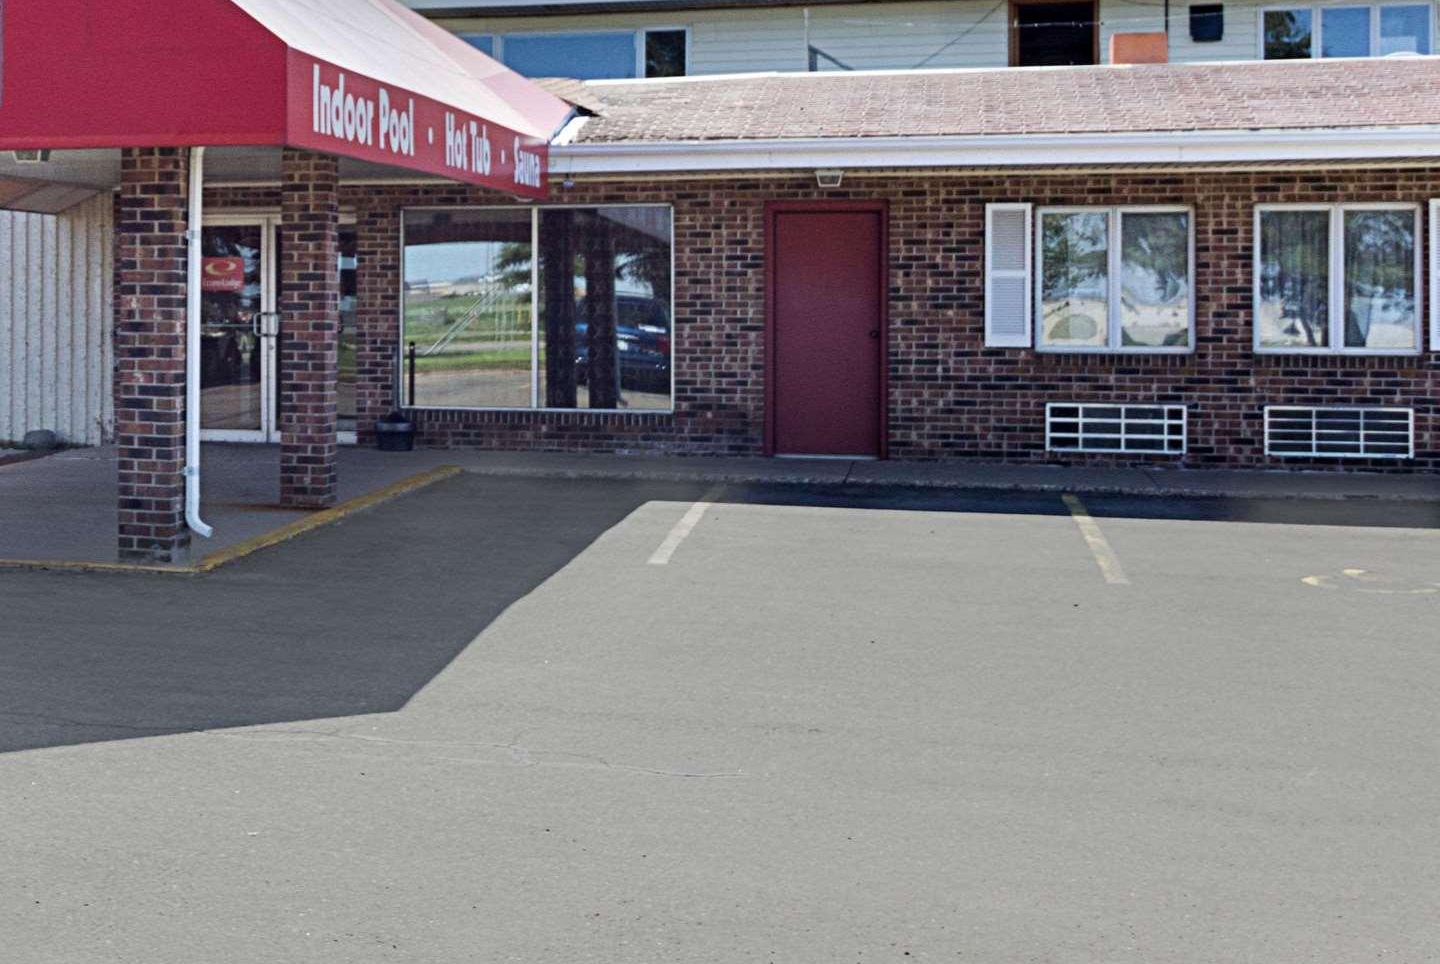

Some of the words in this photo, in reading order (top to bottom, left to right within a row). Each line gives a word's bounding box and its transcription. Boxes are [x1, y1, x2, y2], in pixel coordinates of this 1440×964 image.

[312, 63, 374, 146] Indoor
[379, 88, 415, 157] Pool
[445, 111, 468, 172] Hot
[469, 120, 491, 176] Tub
[513, 136, 541, 188] Sauna
